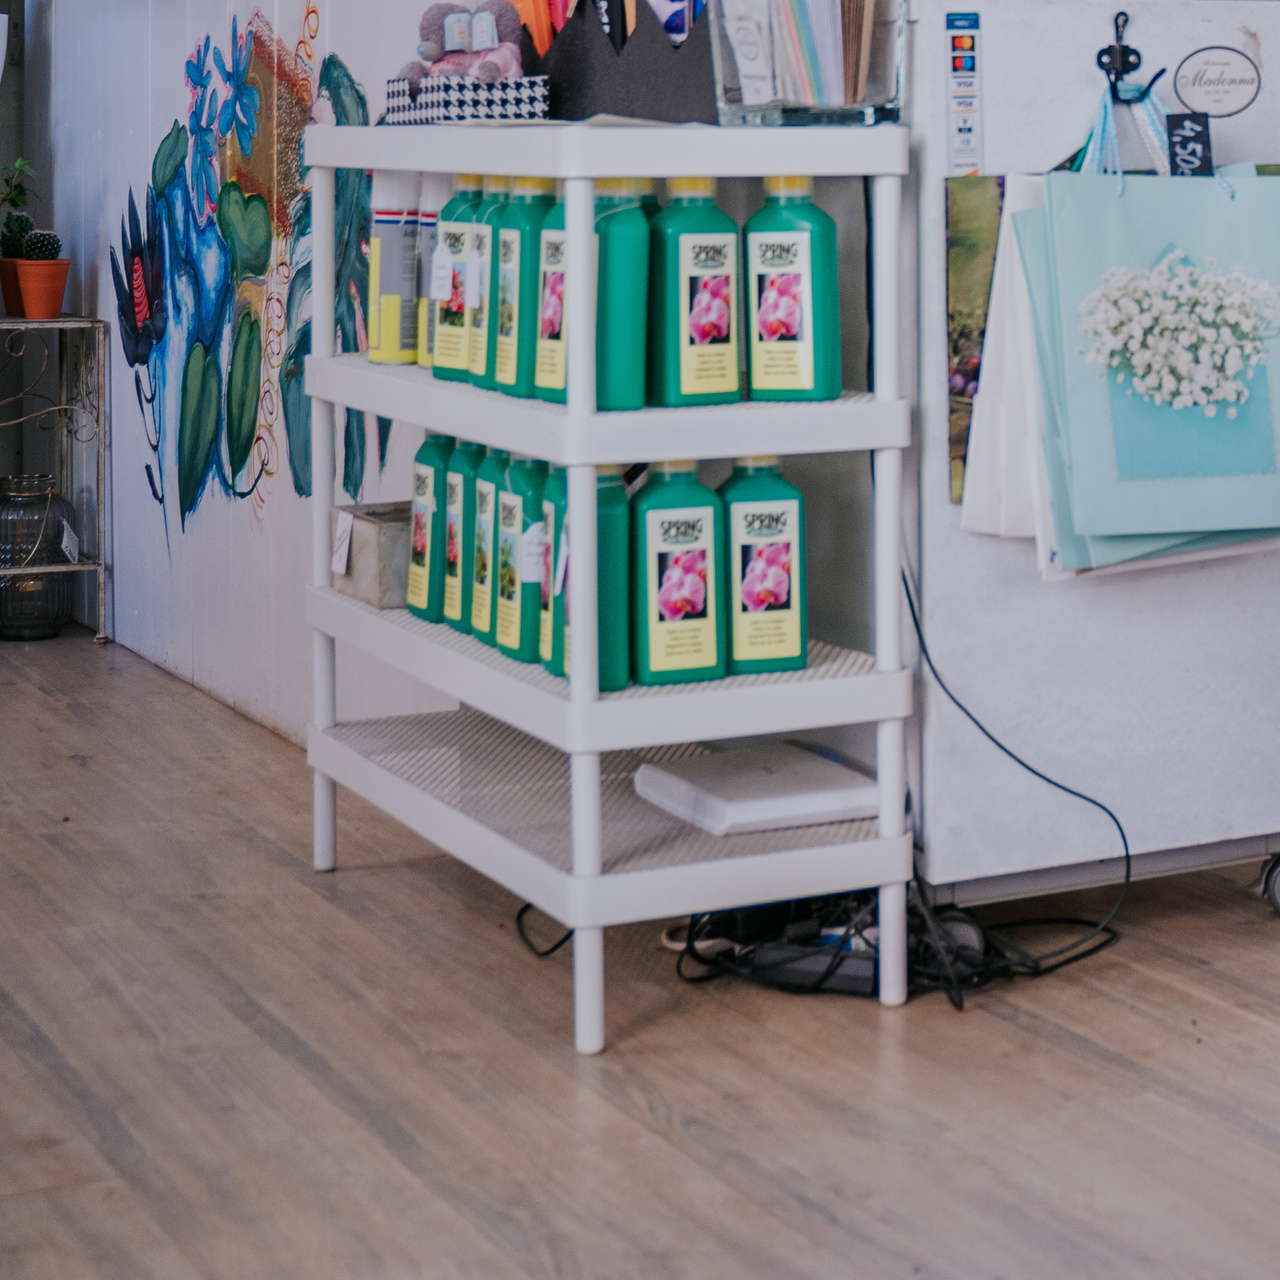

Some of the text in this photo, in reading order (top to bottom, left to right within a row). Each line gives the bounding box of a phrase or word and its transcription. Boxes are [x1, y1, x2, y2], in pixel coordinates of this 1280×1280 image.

[1178, 68, 1256, 88] Madonna
[692, 244, 728, 260] SPRING
[759, 242, 799, 258] SPRING
[660, 518, 703, 536] SPRING
[744, 512, 787, 529] SPRING
